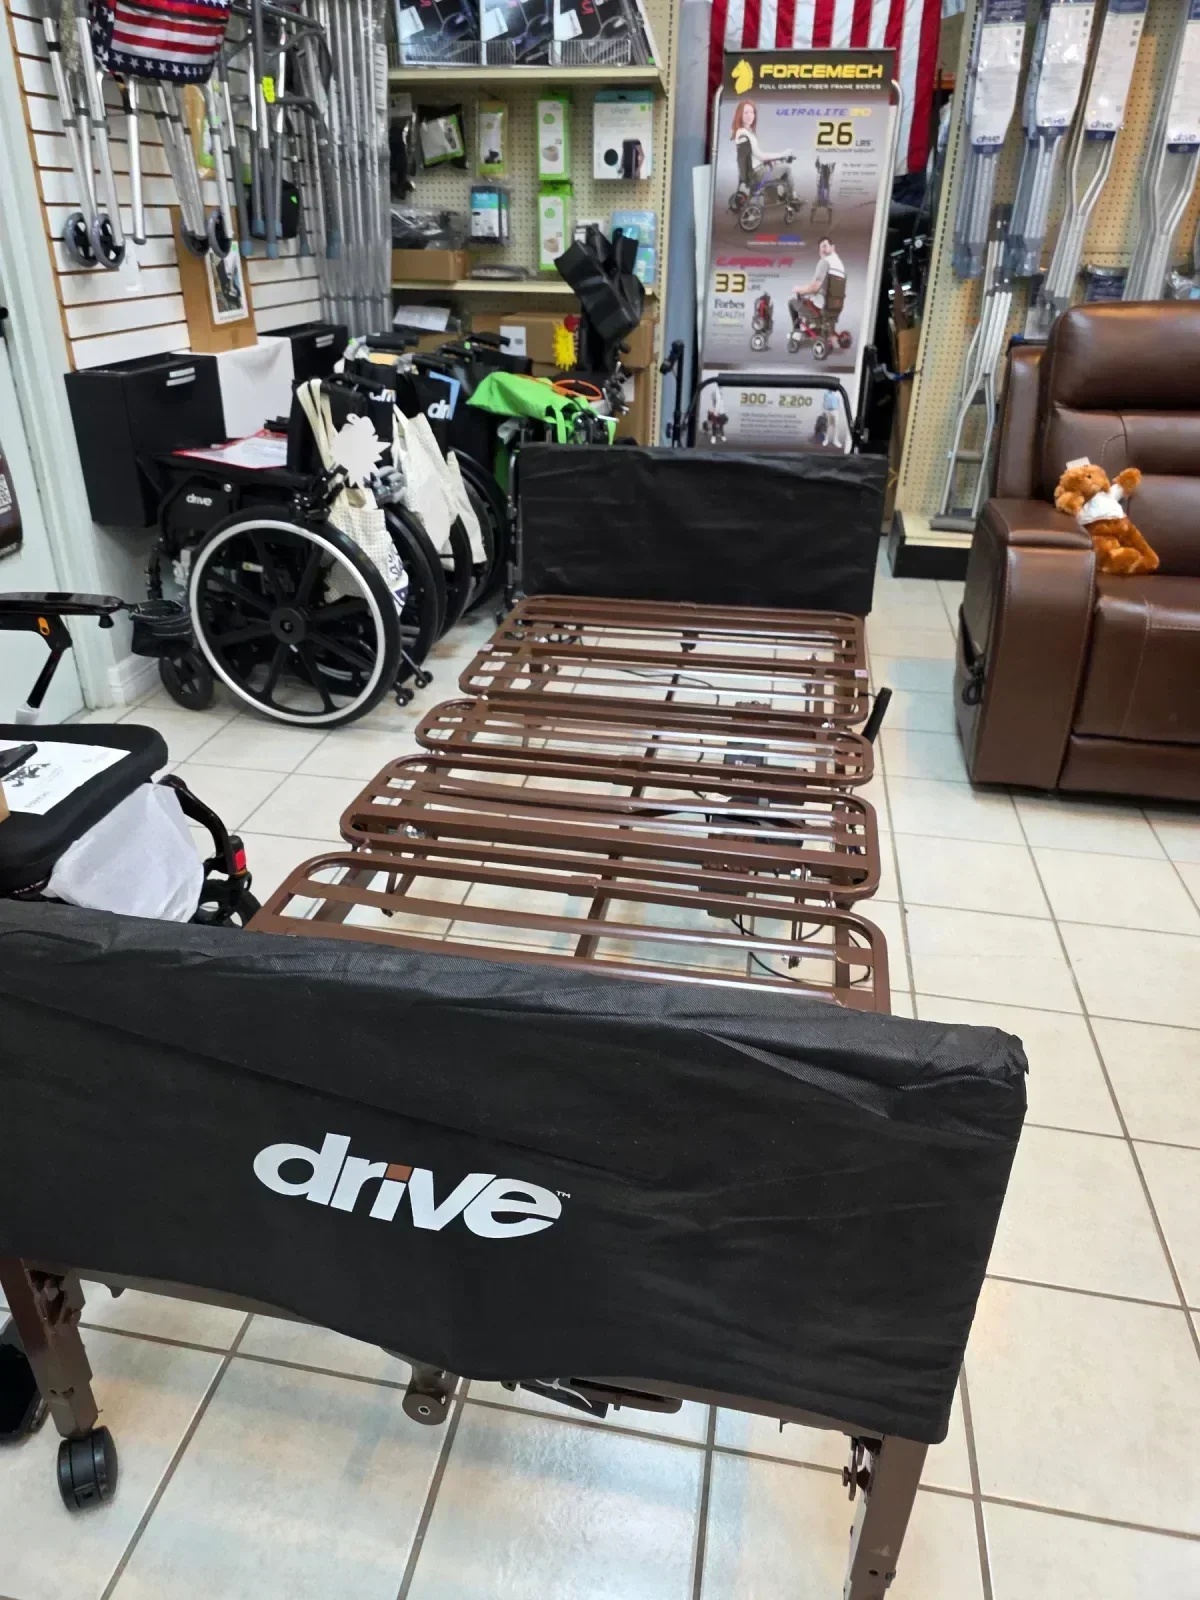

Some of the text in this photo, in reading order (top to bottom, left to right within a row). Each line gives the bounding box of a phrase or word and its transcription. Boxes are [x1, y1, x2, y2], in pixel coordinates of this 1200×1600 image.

[759, 64, 883, 79] FORCEMECH
[817, 122, 853, 146] 26
[715, 273, 746, 293] 33
[714, 298, 745, 310] Forbes
[712, 311, 745, 320] HEALTH
[740, 392, 766, 405] 300
[185, 493, 213, 507] drive
[253, 1132, 563, 1239] drive
